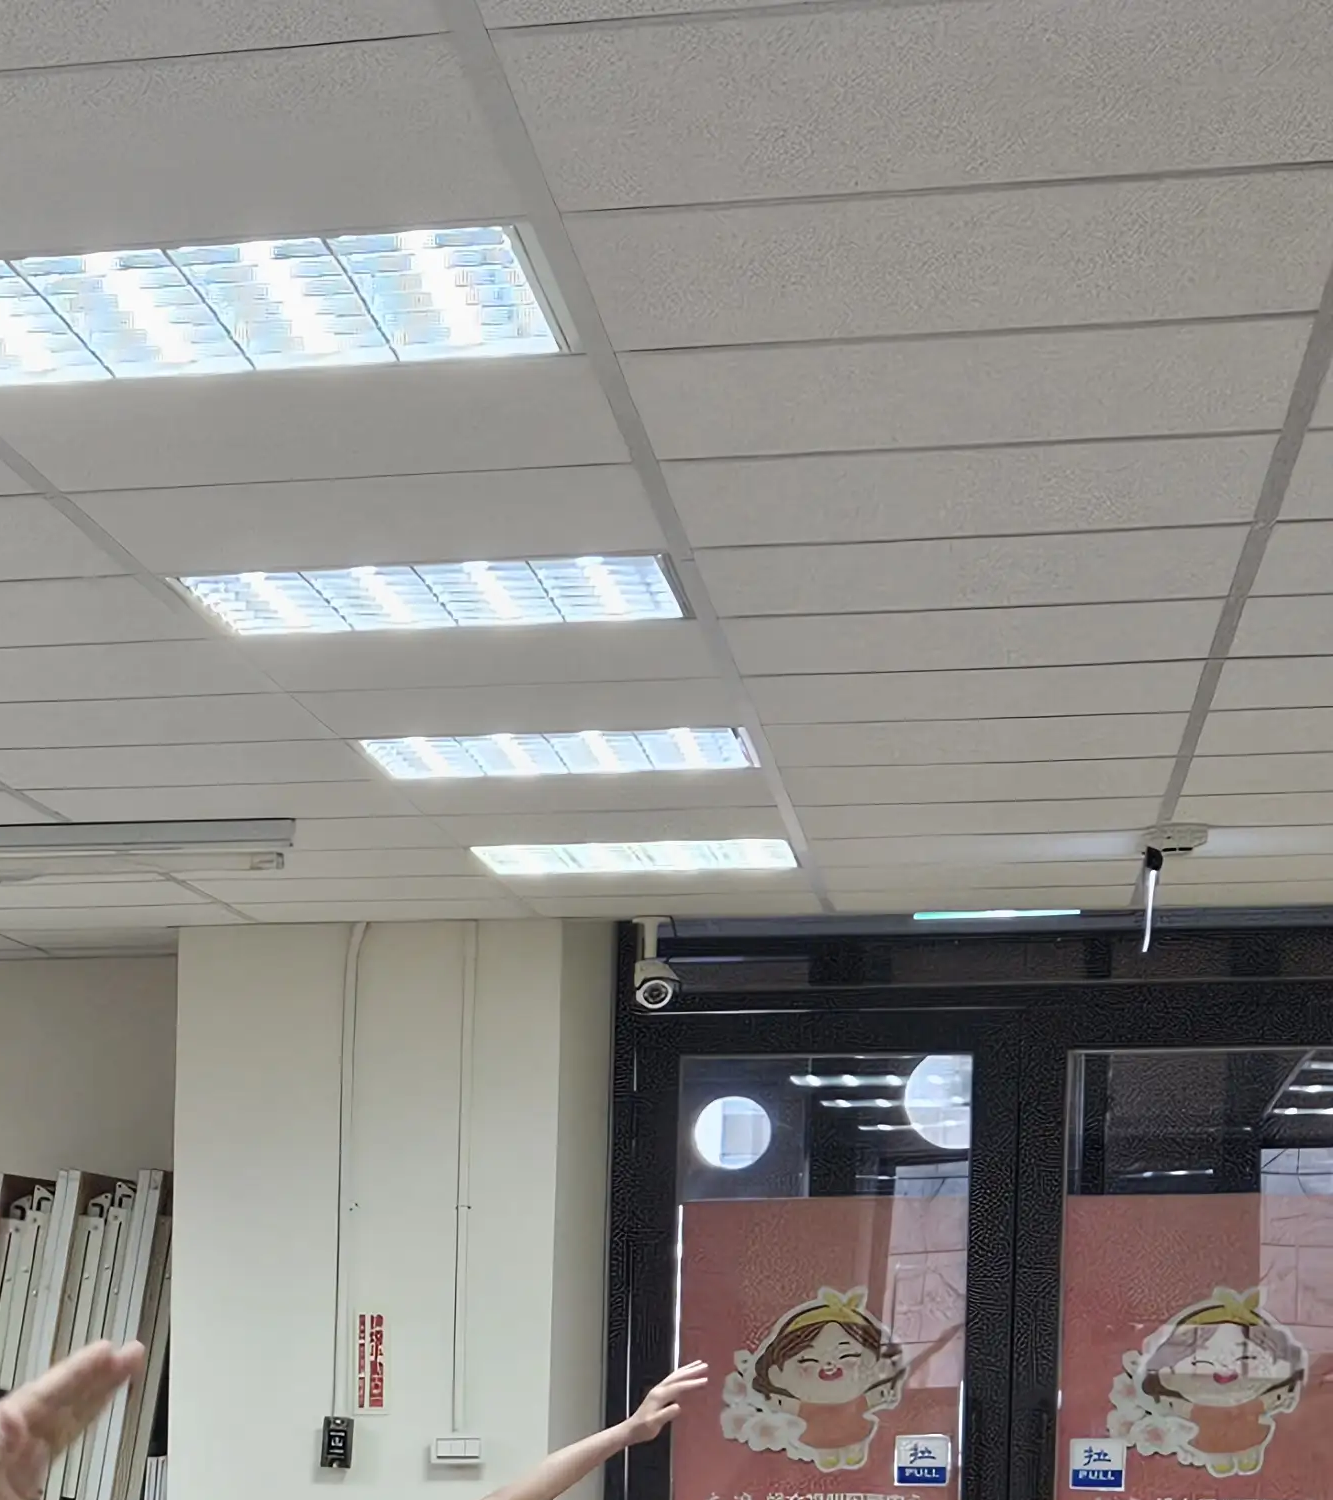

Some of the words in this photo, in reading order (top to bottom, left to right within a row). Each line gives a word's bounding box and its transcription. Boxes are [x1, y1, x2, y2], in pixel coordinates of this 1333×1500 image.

[909, 1442, 936, 1464] 拉
[1083, 1445, 1112, 1466] 拉
[905, 1468, 940, 1478] PULL
[1078, 1470, 1115, 1480] PULL
